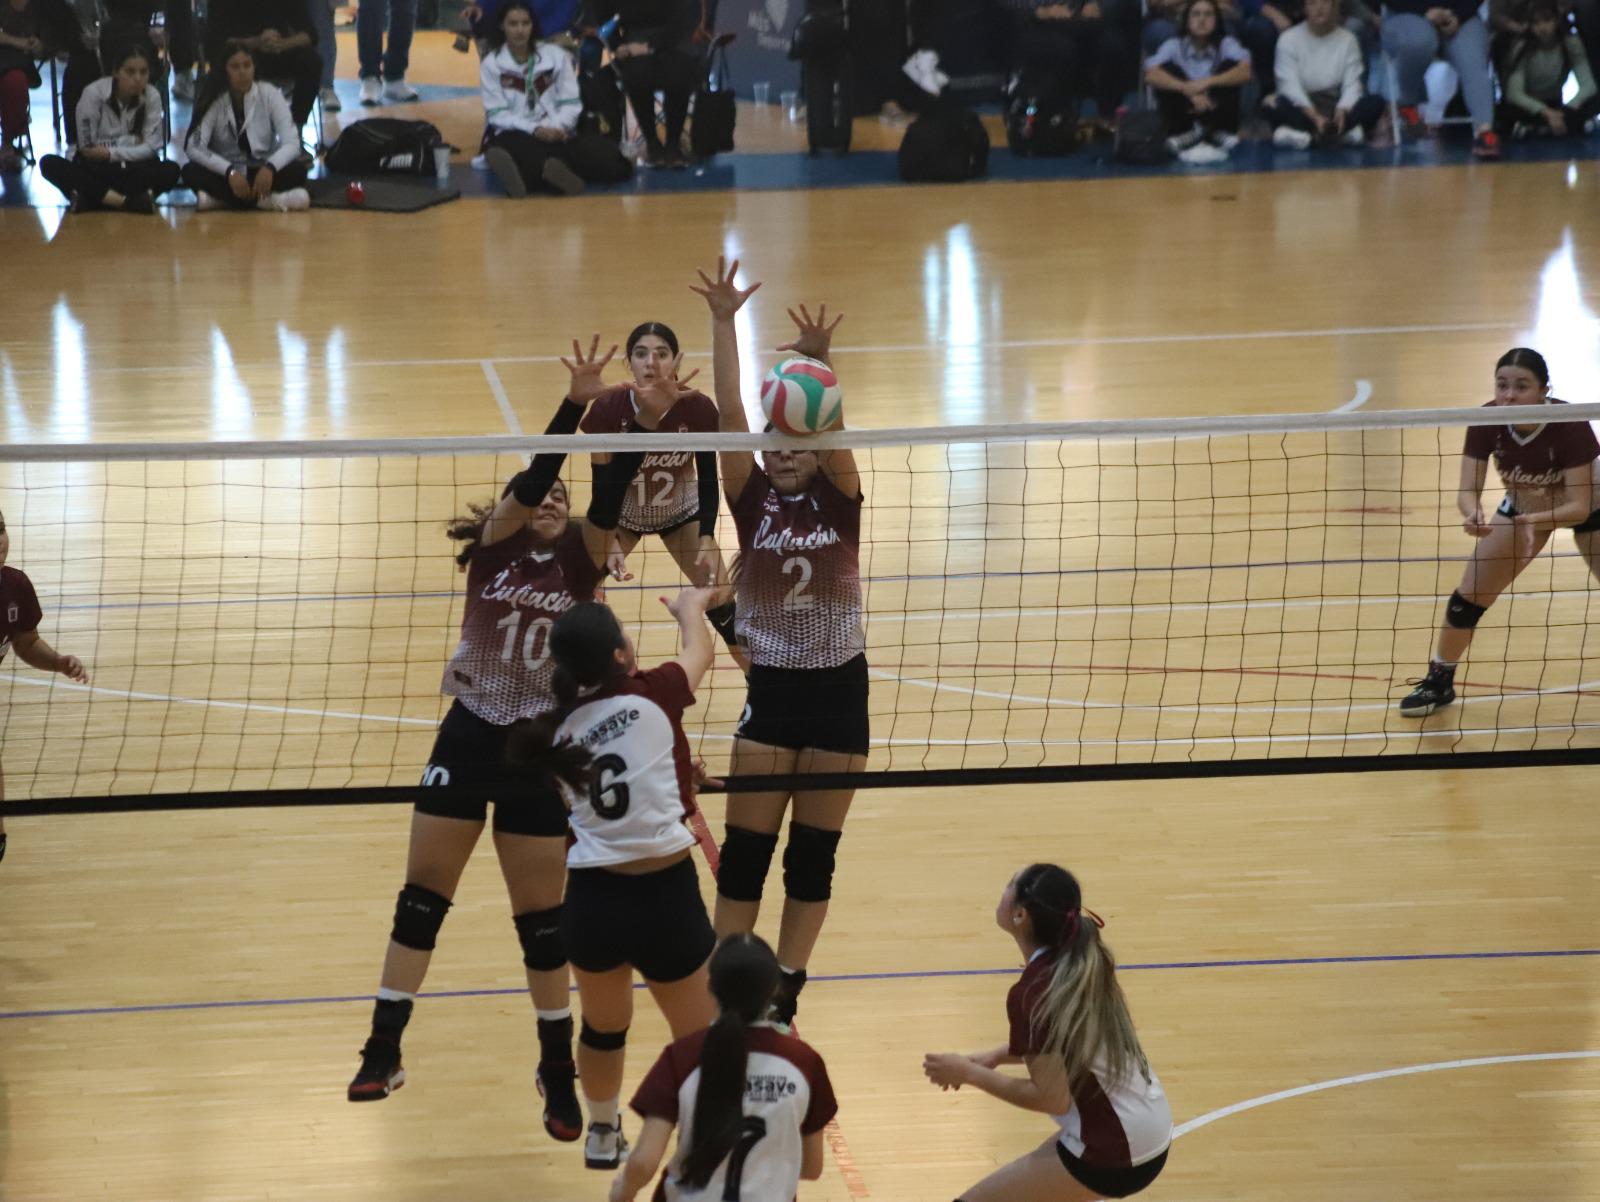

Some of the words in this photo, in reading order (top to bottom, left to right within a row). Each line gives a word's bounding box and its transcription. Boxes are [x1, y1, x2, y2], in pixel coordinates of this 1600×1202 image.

[631, 471, 675, 507] 12
[781, 556, 814, 611] 2
[496, 610, 553, 672] 10
[590, 753, 630, 820] 6
